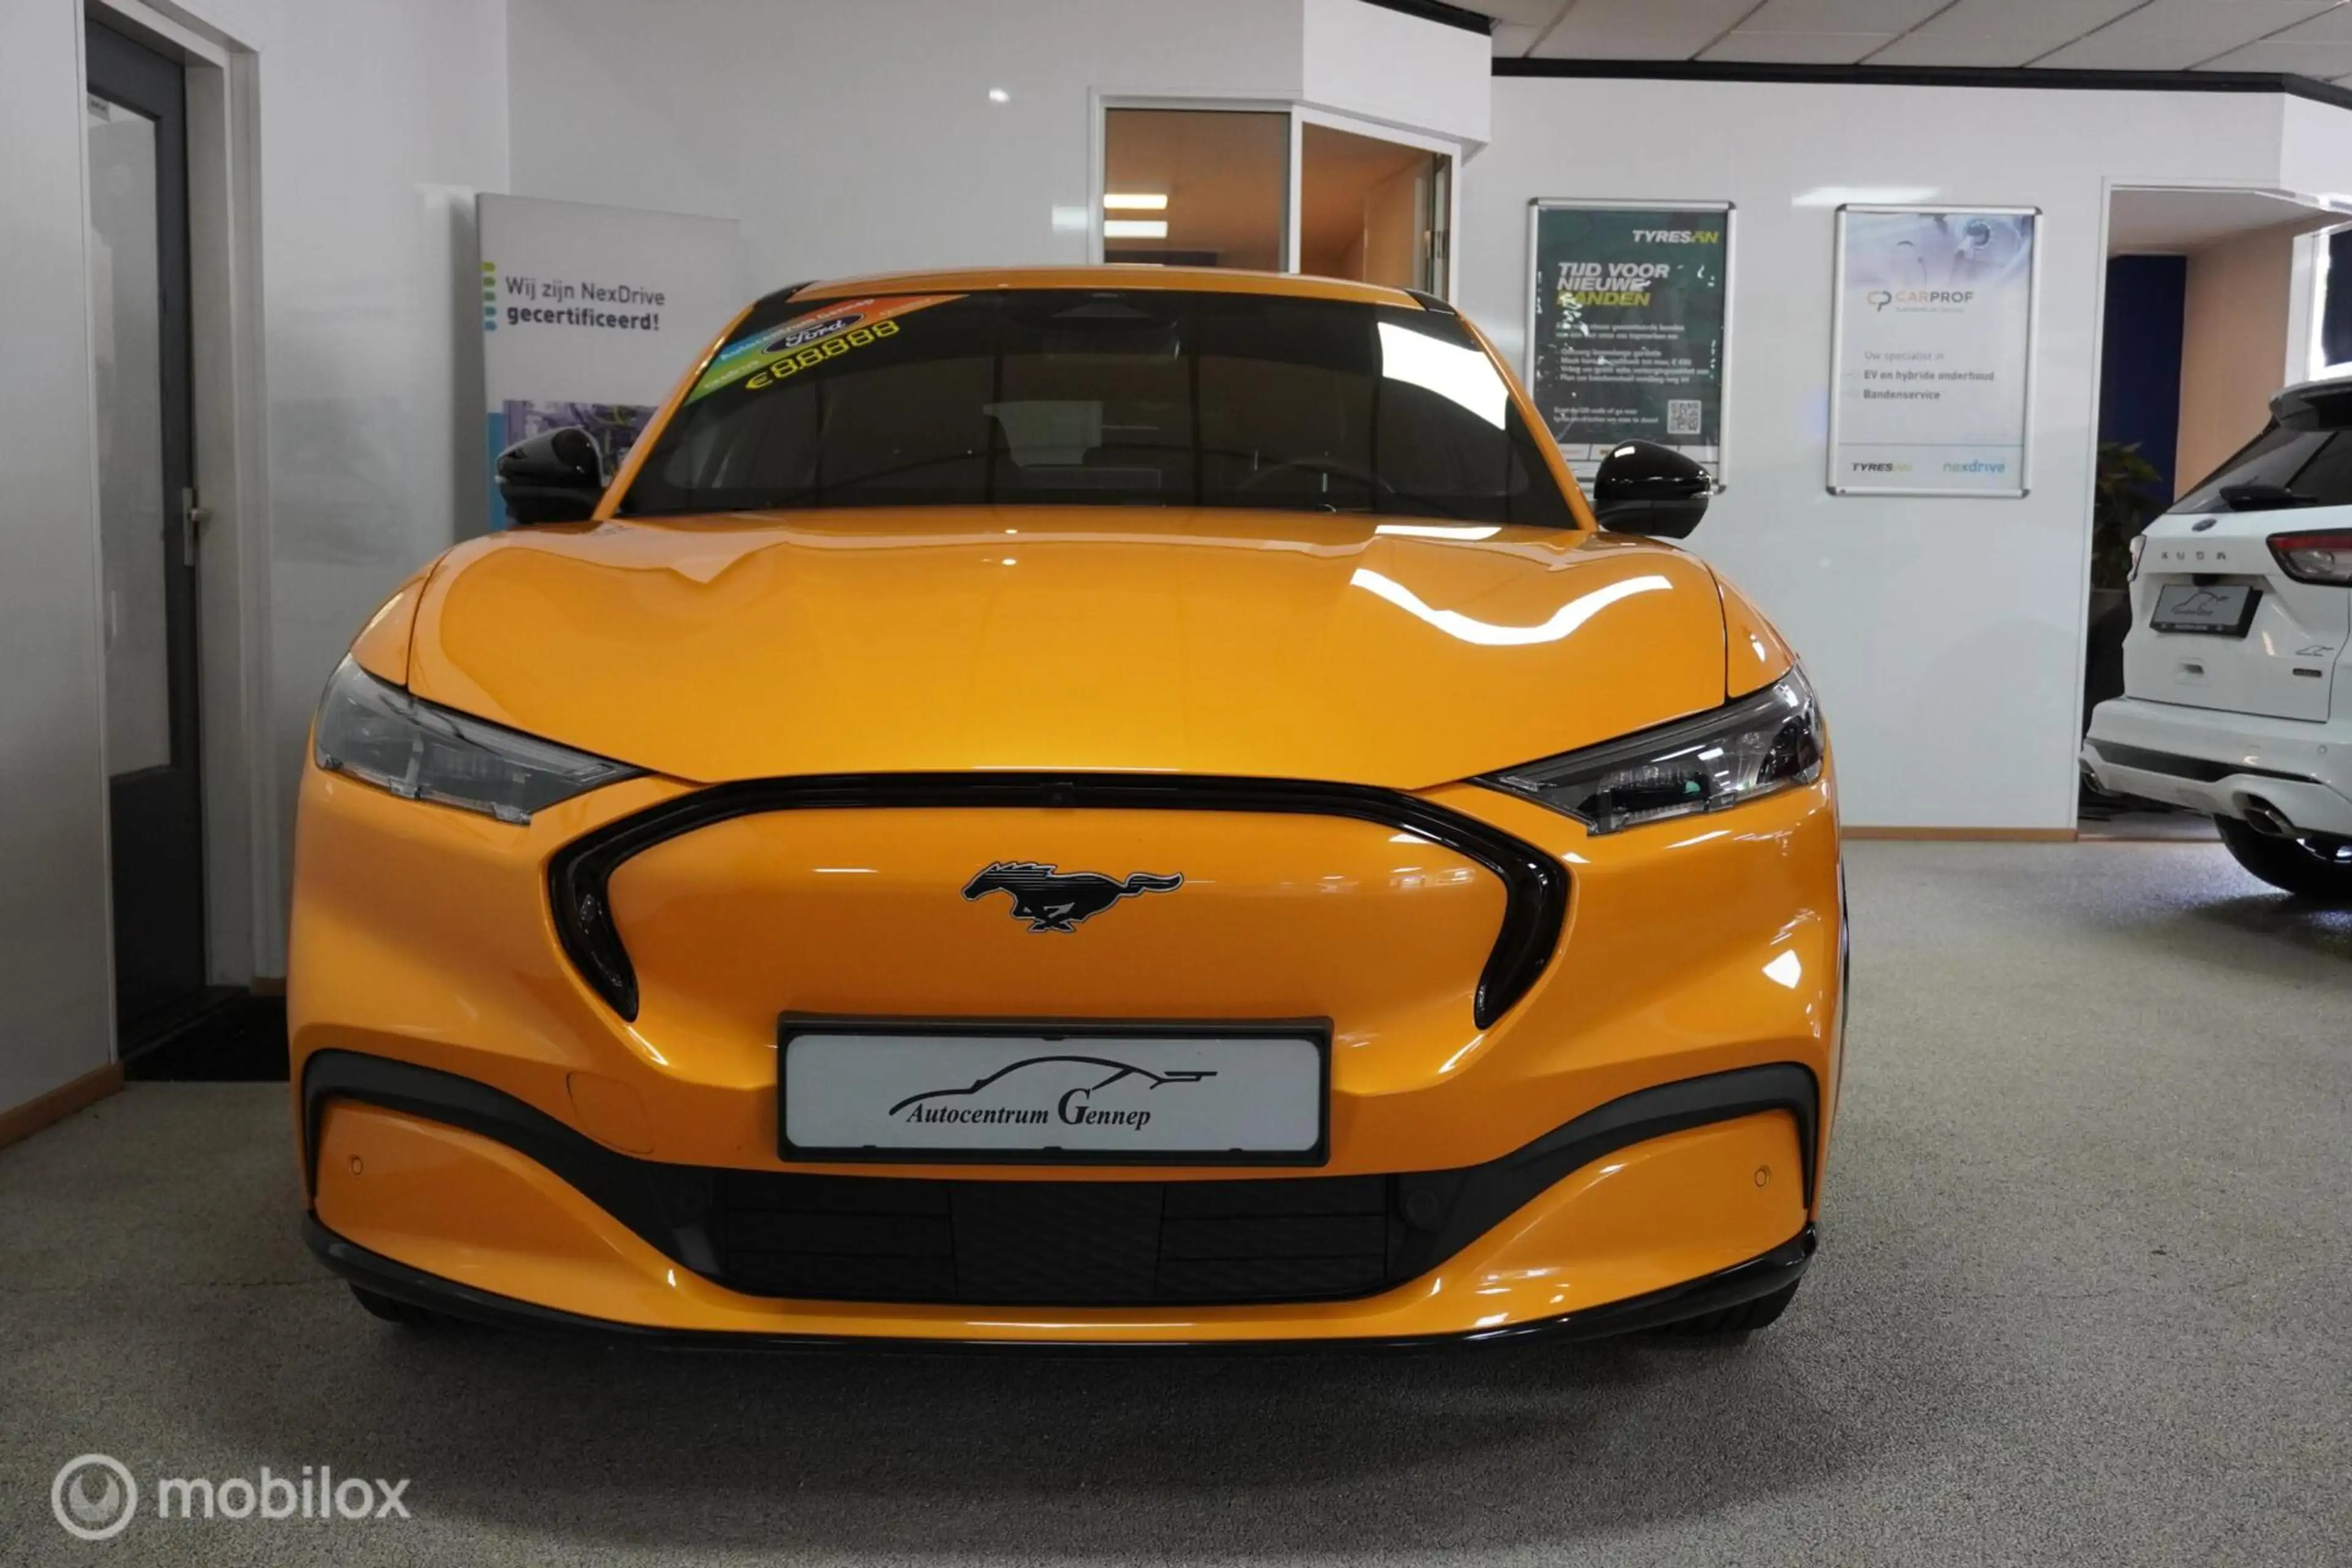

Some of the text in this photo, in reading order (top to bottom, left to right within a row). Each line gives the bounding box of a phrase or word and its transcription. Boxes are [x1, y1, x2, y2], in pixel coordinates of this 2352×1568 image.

[1608, 263, 1670, 278] VOOR
[505, 275, 666, 306] Wij zijn NexDrive
[1557, 277, 1646, 292] NIEUWE
[1895, 290, 1973, 303] CARPROF
[507, 307, 660, 331] gecertificeerd!
[785, 320, 846, 348] Ford
[1864, 369, 1878, 380] EV
[1880, 372, 1893, 380] en
[1896, 370, 1936, 382] hybride
[1863, 389, 1941, 399] Bandenservice
[906, 1088, 1151, 1131] Autocentrum Gennep
